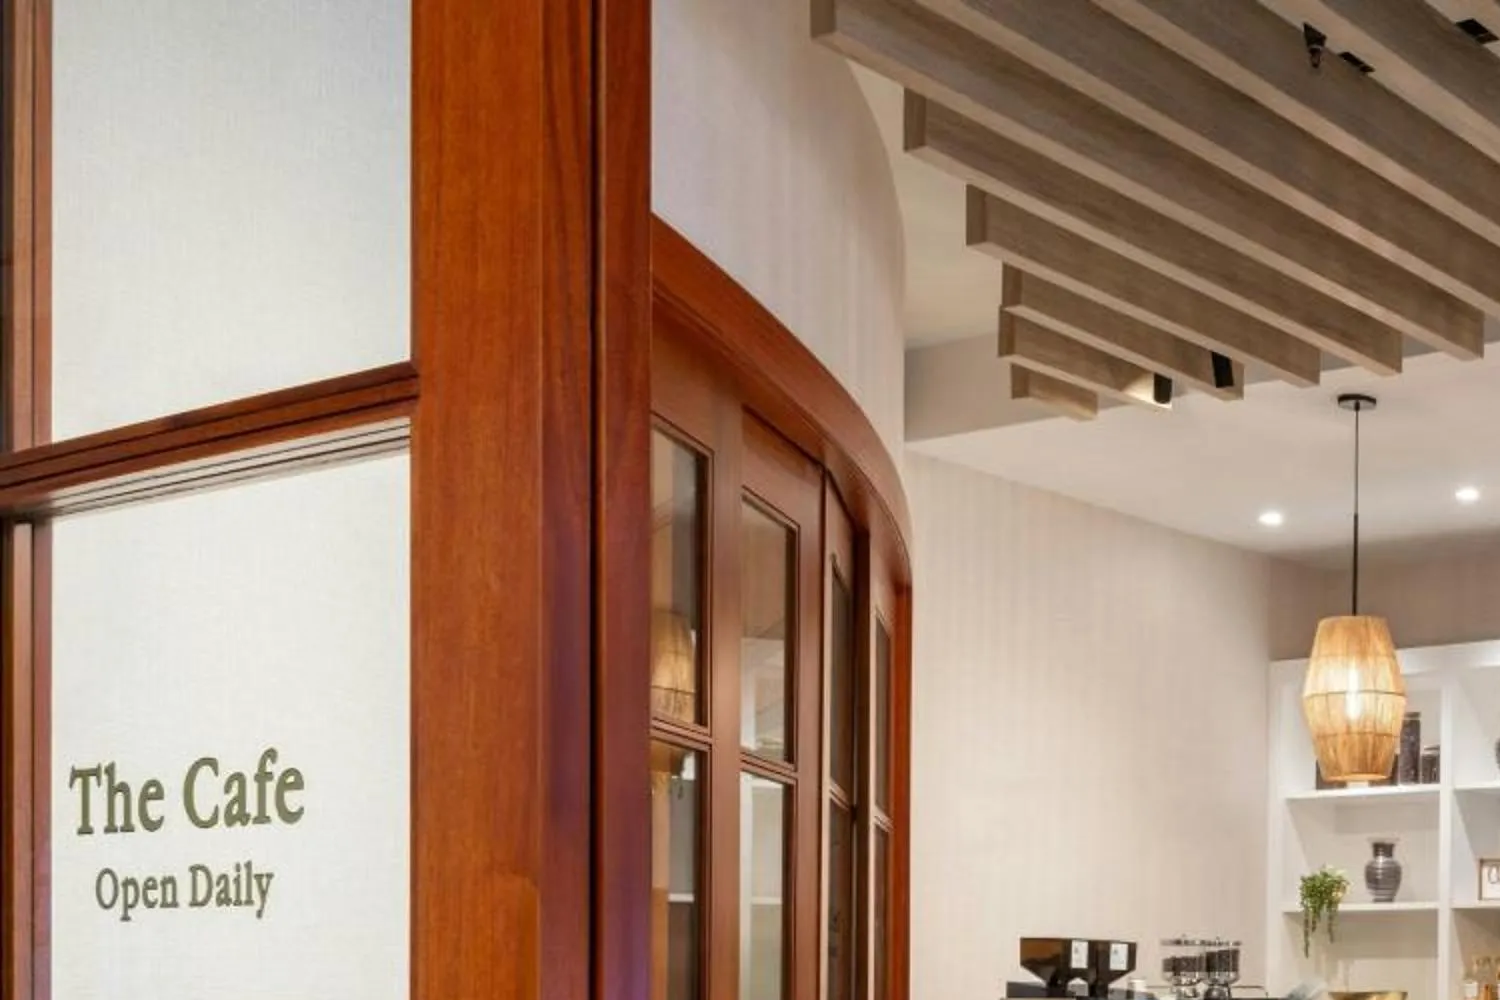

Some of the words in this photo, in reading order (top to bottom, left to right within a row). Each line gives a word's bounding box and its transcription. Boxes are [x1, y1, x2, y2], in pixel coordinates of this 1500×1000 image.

[69, 761, 165, 835] The
[183, 748, 304, 829] Cafe
[95, 867, 179, 922] Open
[188, 860, 274, 919] Daily
